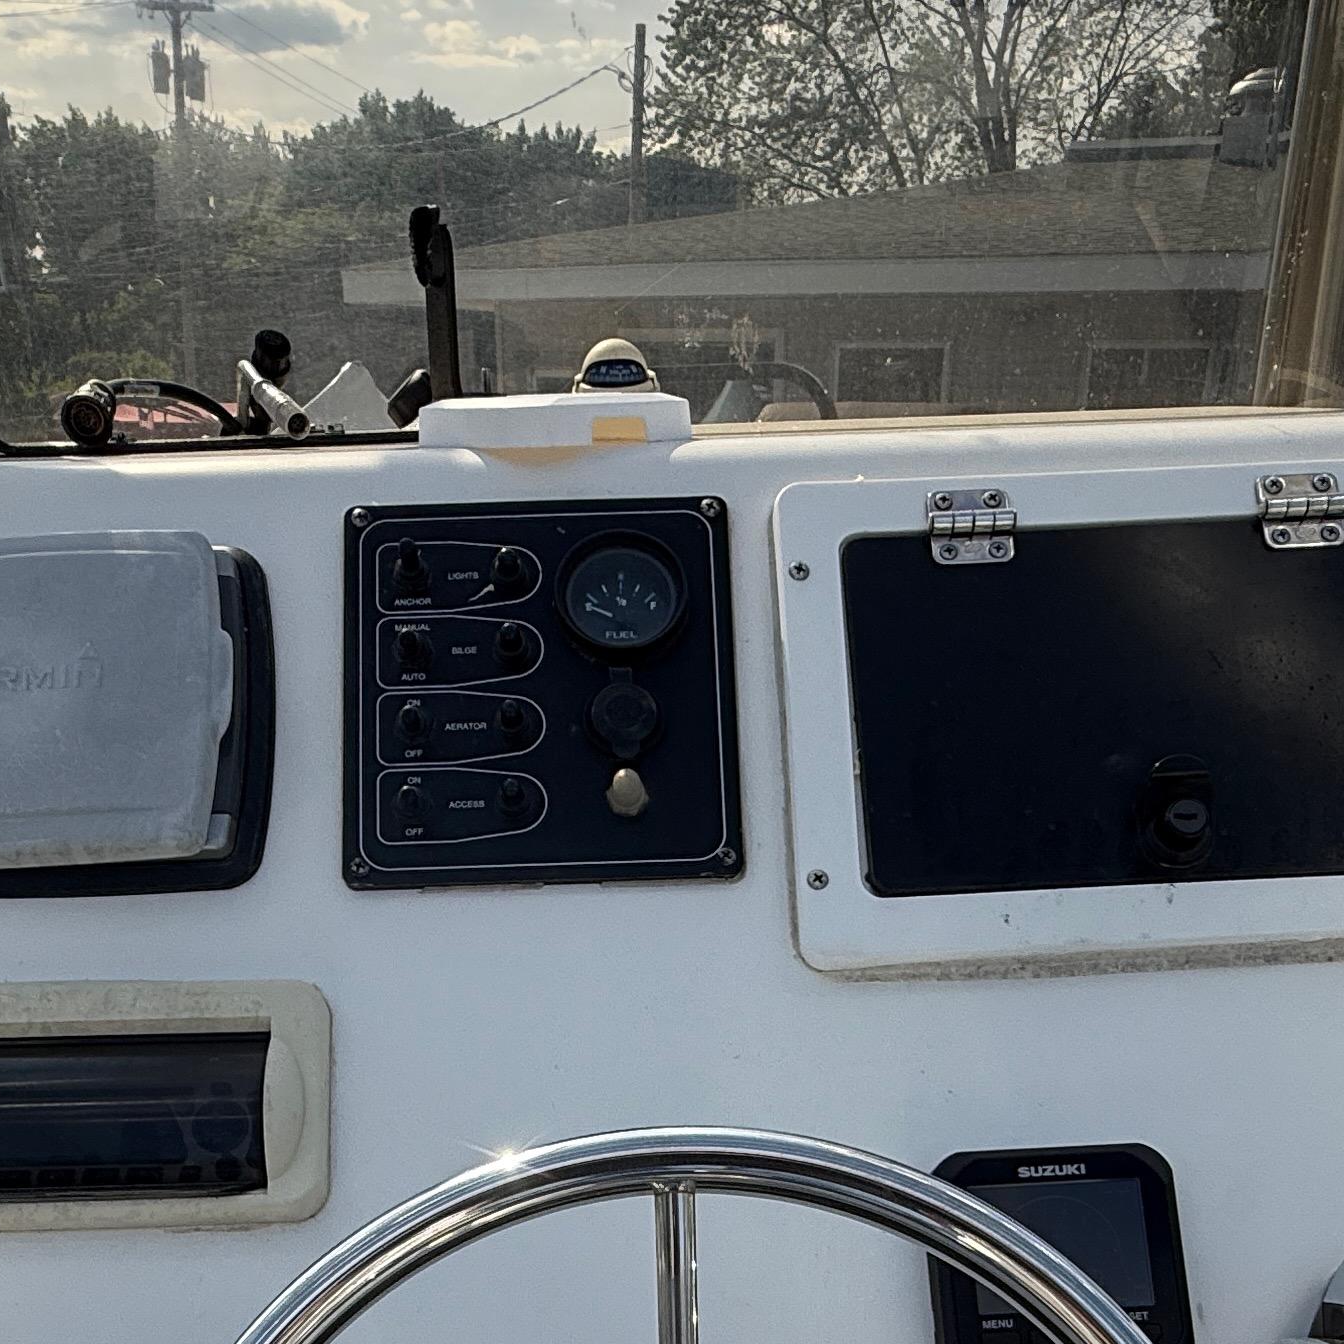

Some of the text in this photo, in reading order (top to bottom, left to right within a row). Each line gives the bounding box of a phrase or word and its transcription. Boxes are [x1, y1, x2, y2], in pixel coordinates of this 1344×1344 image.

[447, 572, 479, 580] LIGHTS
[394, 598, 432, 606] ANCHOR
[394, 624, 431, 632] MANUAL
[605, 631, 638, 639] FUEL
[451, 647, 478, 655] BILGE
[401, 673, 426, 681] AUTO
[406, 699, 421, 707] ON
[444, 722, 488, 731] AERATOR
[405, 750, 424, 758] OFF
[407, 776, 421, 784] ON
[448, 800, 485, 809] ACCESS
[405, 828, 424, 836] OFF
[1017, 1163, 1087, 1178] SUZUKI
[982, 1319, 1014, 1329] MENU
